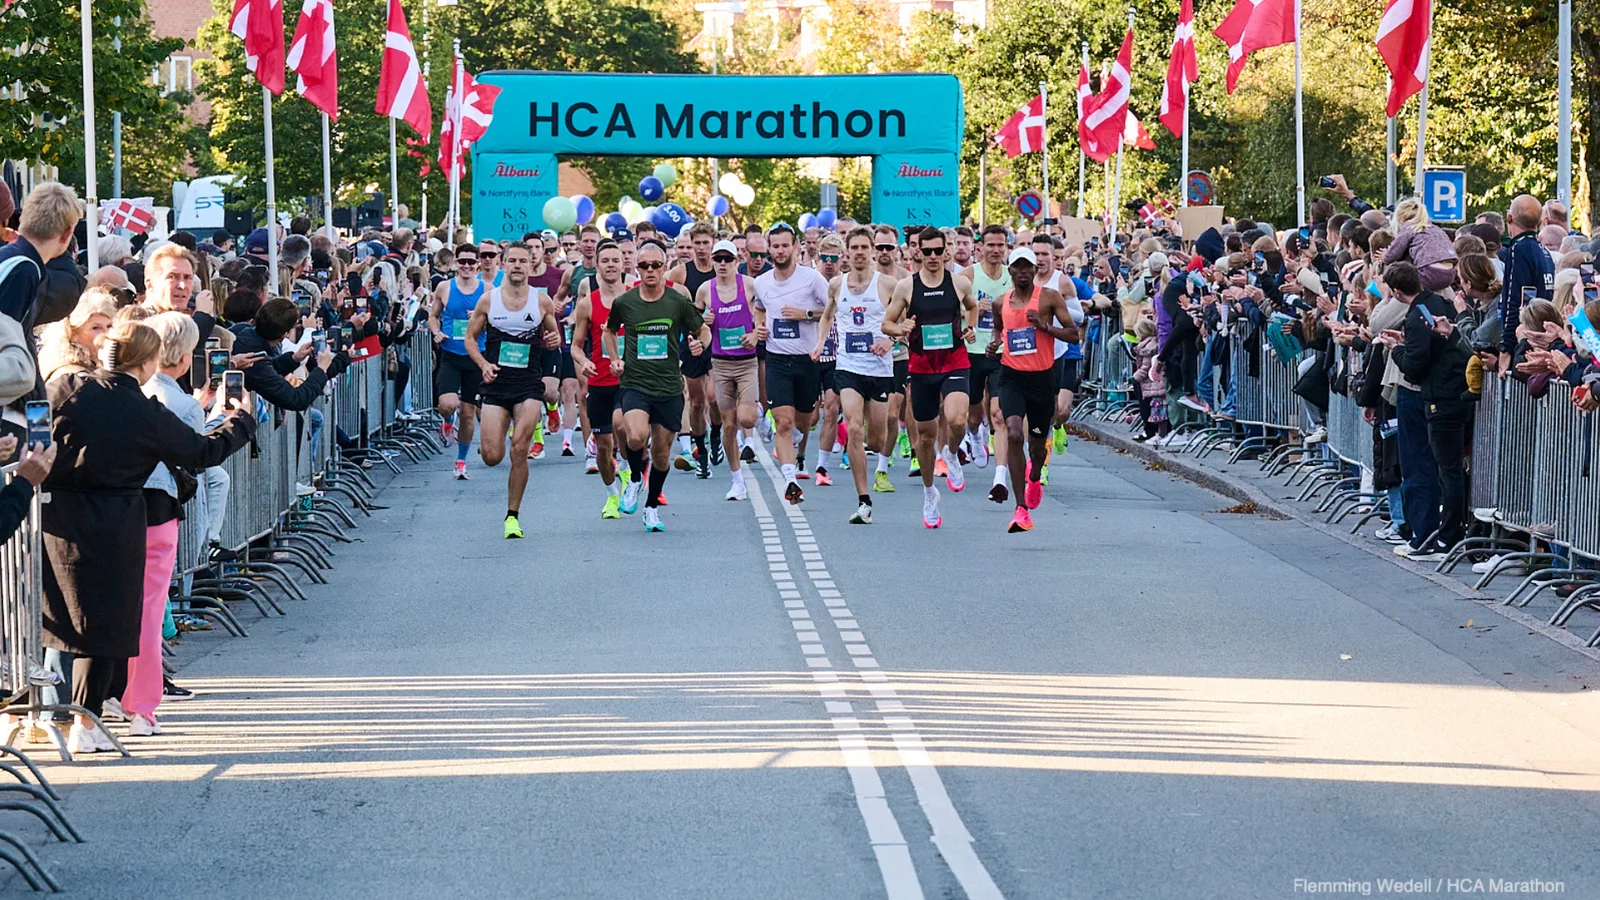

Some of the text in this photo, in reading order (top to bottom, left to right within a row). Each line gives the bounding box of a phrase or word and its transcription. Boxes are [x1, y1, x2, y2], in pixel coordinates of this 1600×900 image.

[529, 101, 906, 139] HCA Marathon
[488, 189, 551, 199] Nordfyns Bank
[892, 189, 955, 199] Nordfyns Bank
